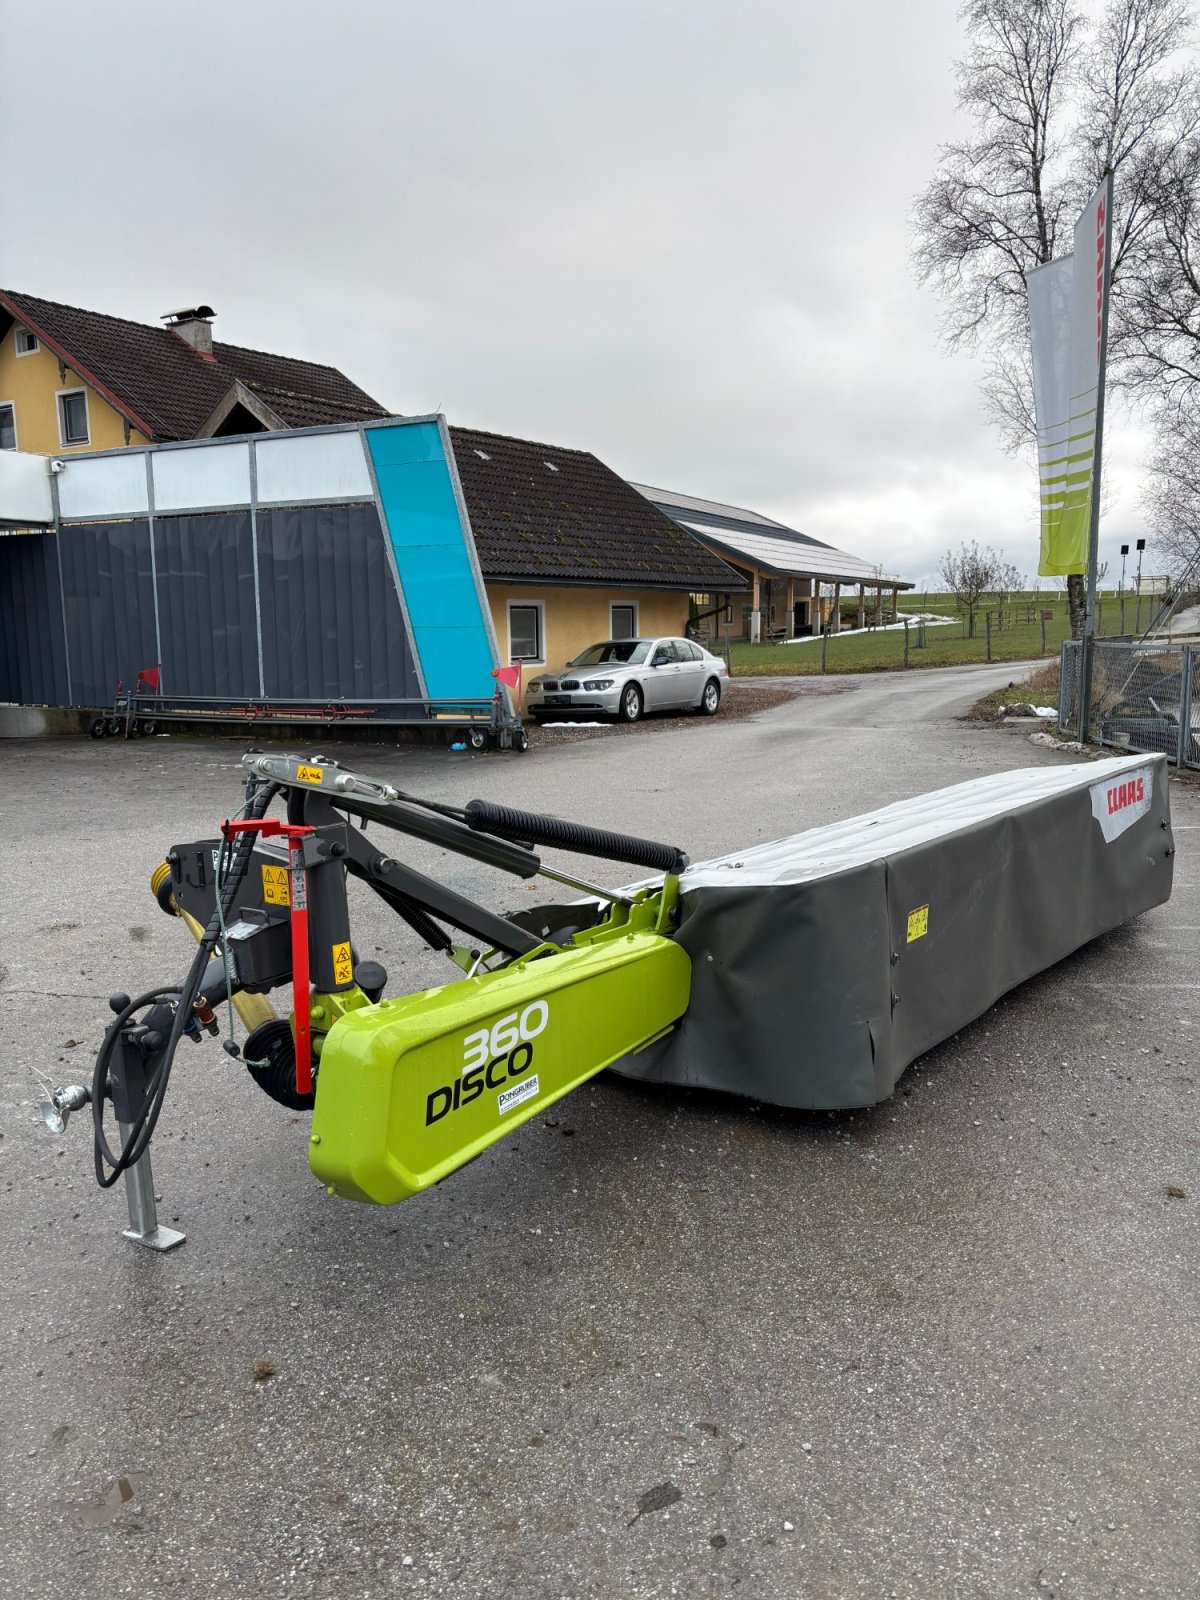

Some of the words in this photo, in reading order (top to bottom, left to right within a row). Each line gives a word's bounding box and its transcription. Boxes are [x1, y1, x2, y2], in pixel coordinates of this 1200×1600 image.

[1107, 778, 1144, 815] CLAAS
[462, 1000, 549, 1076] 360
[426, 1042, 534, 1127] DISCO
[499, 1077, 537, 1106] PONGRUBER
